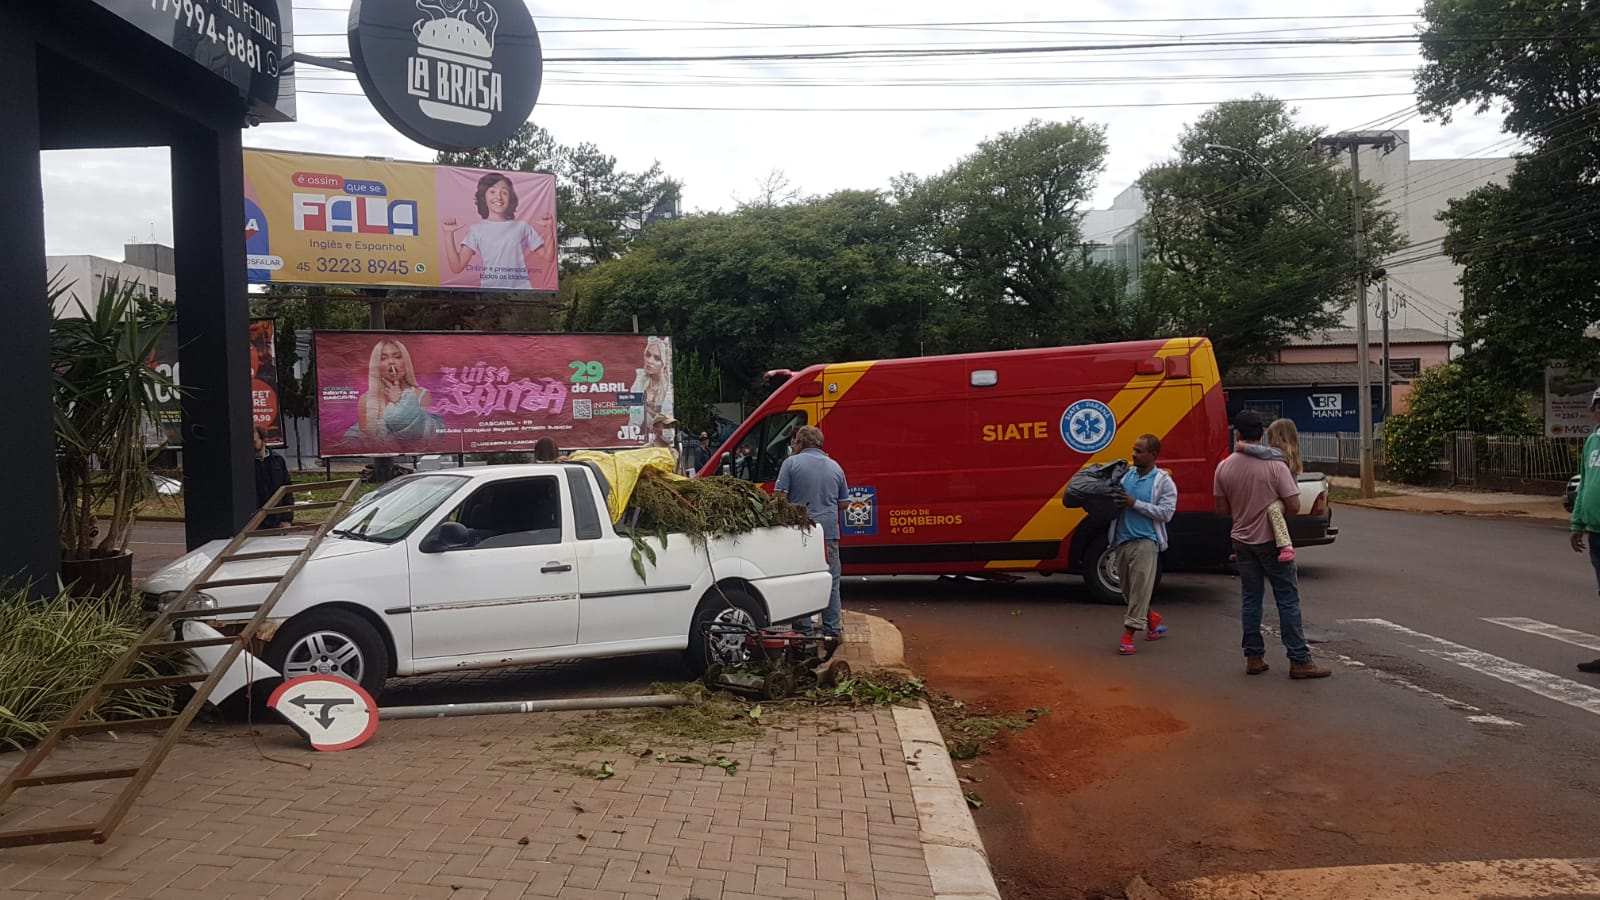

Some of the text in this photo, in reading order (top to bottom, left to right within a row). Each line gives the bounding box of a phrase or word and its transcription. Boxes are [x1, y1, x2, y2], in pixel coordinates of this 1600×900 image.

[243, 2, 277, 45] PEDIDO
[407, 56, 502, 112] LA BRASA
[298, 174, 338, 186] é assim
[347, 183, 381, 193] que se
[293, 192, 419, 236] FALA
[310, 239, 343, 251] Inglês
[355, 240, 406, 252] Espanhol
[296, 257, 409, 275] 45 3223 8945
[1549, 361, 1569, 369] LOJ
[568, 360, 604, 383] 29
[571, 382, 629, 393] de ABRIL
[593, 401, 618, 409] INGRE
[1312, 409, 1342, 418] MANN
[982, 421, 1049, 442] SIATE
[889, 508, 930, 517] CORPO DE
[889, 515, 963, 527] BOMBEIROS
[902, 526, 915, 534] GB
